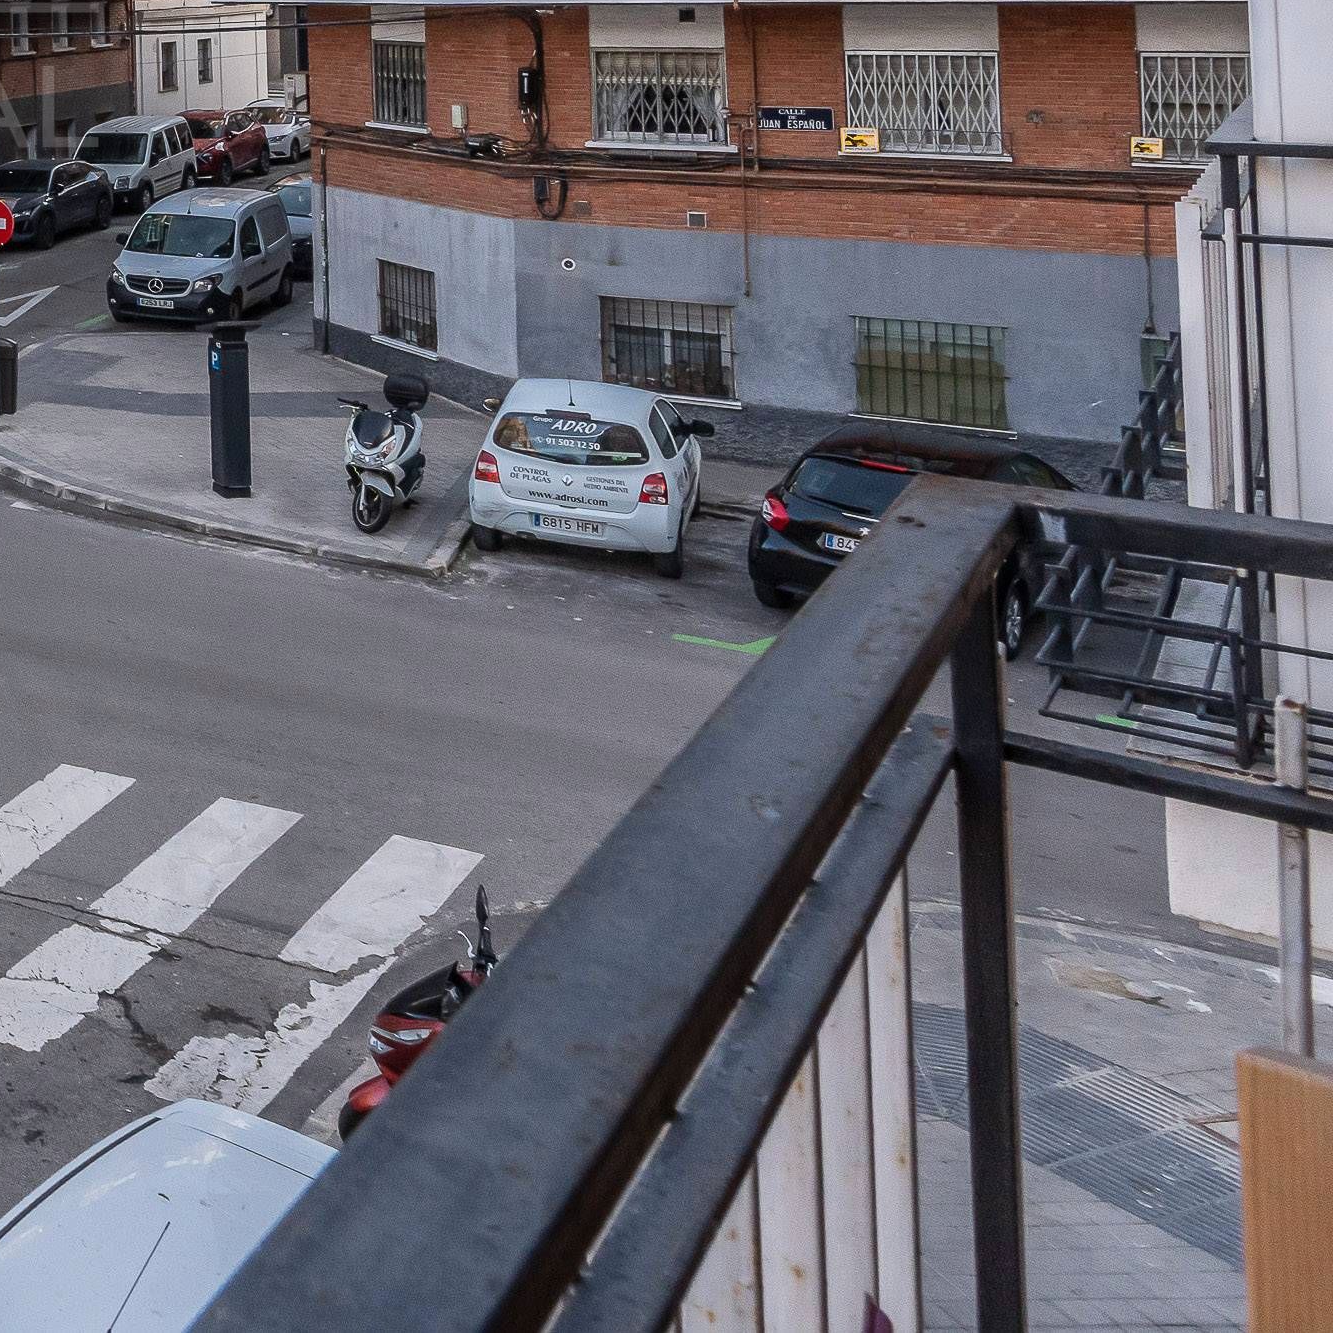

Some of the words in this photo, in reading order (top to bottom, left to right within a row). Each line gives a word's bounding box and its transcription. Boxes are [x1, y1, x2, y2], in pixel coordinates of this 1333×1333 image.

[759, 119, 781, 129] JUAN
[787, 119, 827, 130] ESPAÑOL
[212, 351, 218, 365] P
[551, 419, 597, 434] ADRO
[558, 439, 574, 447] 502
[576, 440, 587, 448] 12
[588, 442, 600, 450] 50
[513, 466, 549, 476] CONTROL
[522, 474, 551, 484] PLAGAS
[542, 517, 572, 530] 6815
[576, 521, 599, 534] HFM
